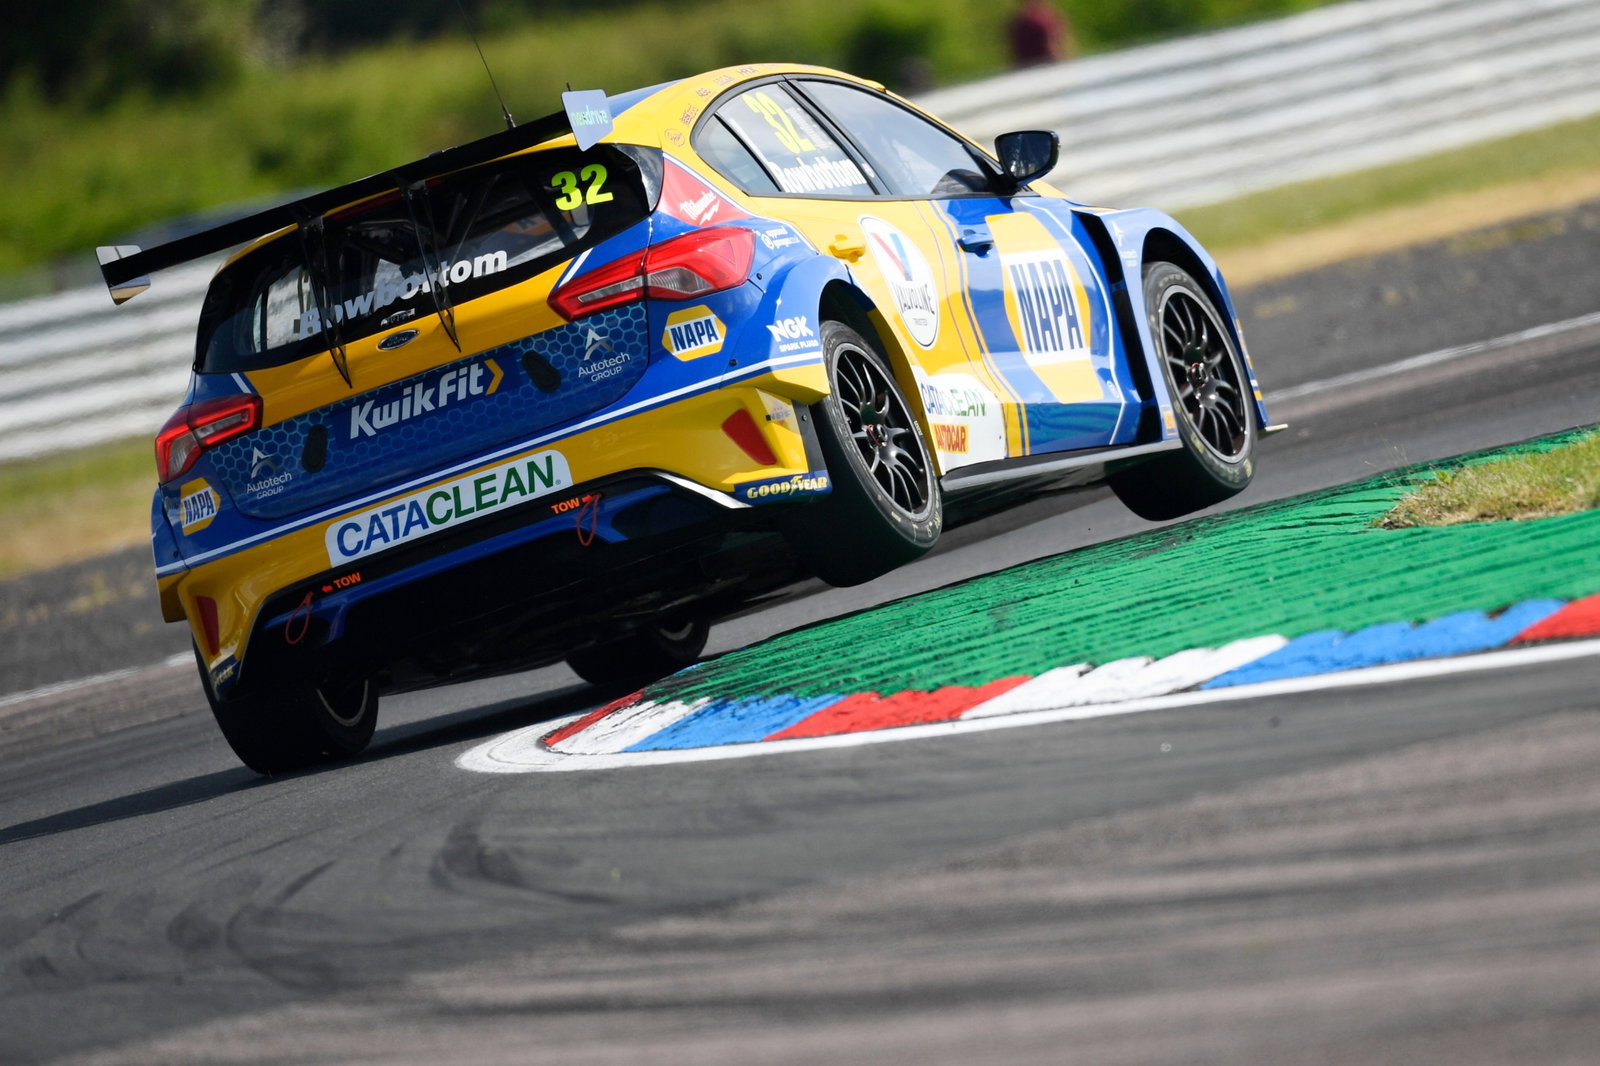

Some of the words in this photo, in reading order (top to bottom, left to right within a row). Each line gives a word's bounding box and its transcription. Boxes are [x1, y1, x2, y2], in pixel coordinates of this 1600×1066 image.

[742, 91, 817, 154] 32
[551, 164, 614, 211] 32
[1009, 259, 1084, 355] NAPA
[670, 318, 719, 352] NAPA
[766, 315, 814, 342] NGK
[578, 352, 631, 378] Autotech
[591, 366, 623, 382] GROUP
[934, 424, 967, 453] AUTOCAR
[246, 472, 293, 494] Autotech
[256, 485, 285, 500] GROUP
[747, 475, 828, 499] GOODYEAR
[184, 490, 215, 525] NAPA
[337, 455, 555, 557] CATACLEAN
[551, 497, 580, 514] TOW
[333, 571, 361, 589] TOW
